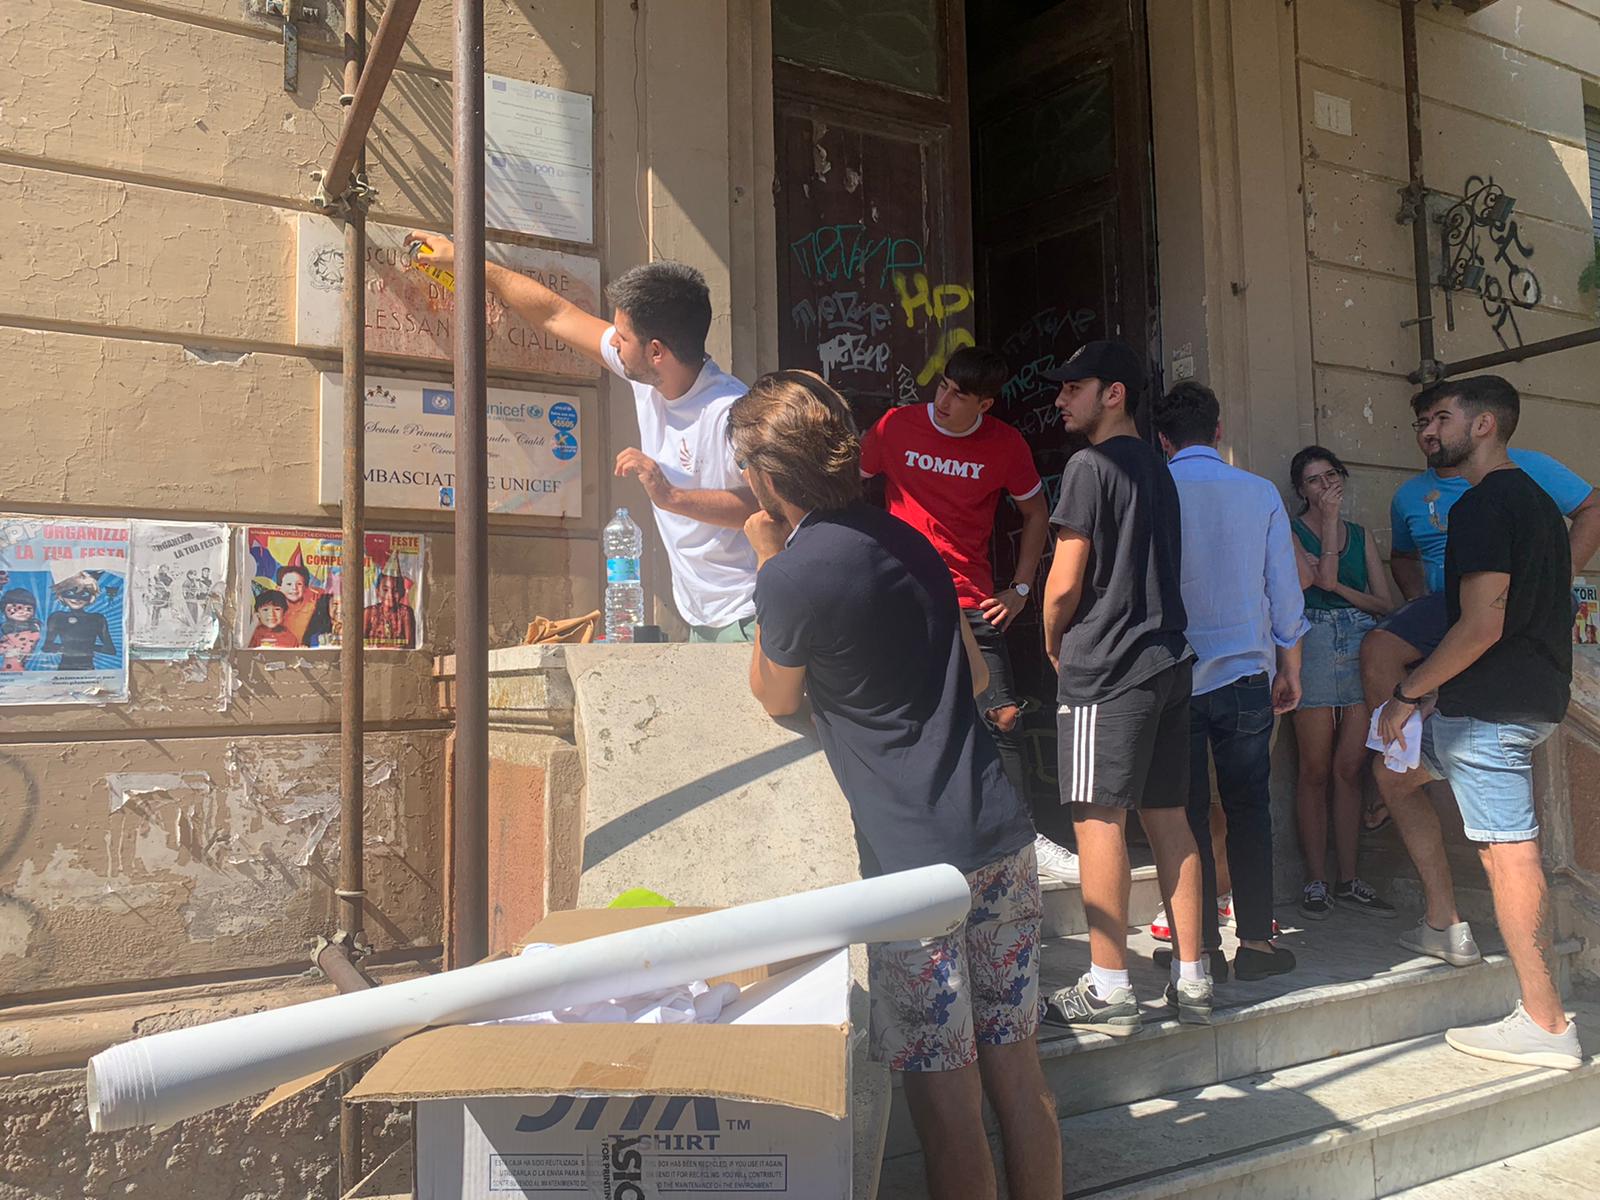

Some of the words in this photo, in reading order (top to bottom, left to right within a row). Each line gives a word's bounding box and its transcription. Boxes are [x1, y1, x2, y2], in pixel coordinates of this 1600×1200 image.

[402, 422, 453, 439] Primaria
[904, 450, 985, 480] TOMMY
[500, 477, 561, 494] UNICEF
[42, 525, 129, 541] ORGANIZZA
[391, 536, 419, 547] FESTE
[15, 544, 34, 560] LA
[42, 545, 73, 560] TUA
[80, 547, 125, 559] FESTA
[173, 549, 185, 560] LA
[184, 544, 200, 556] TUA
[200, 535, 224, 550] FESTA
[726, 1119, 750, 1131] TM
[602, 1142, 610, 1162] FOR
